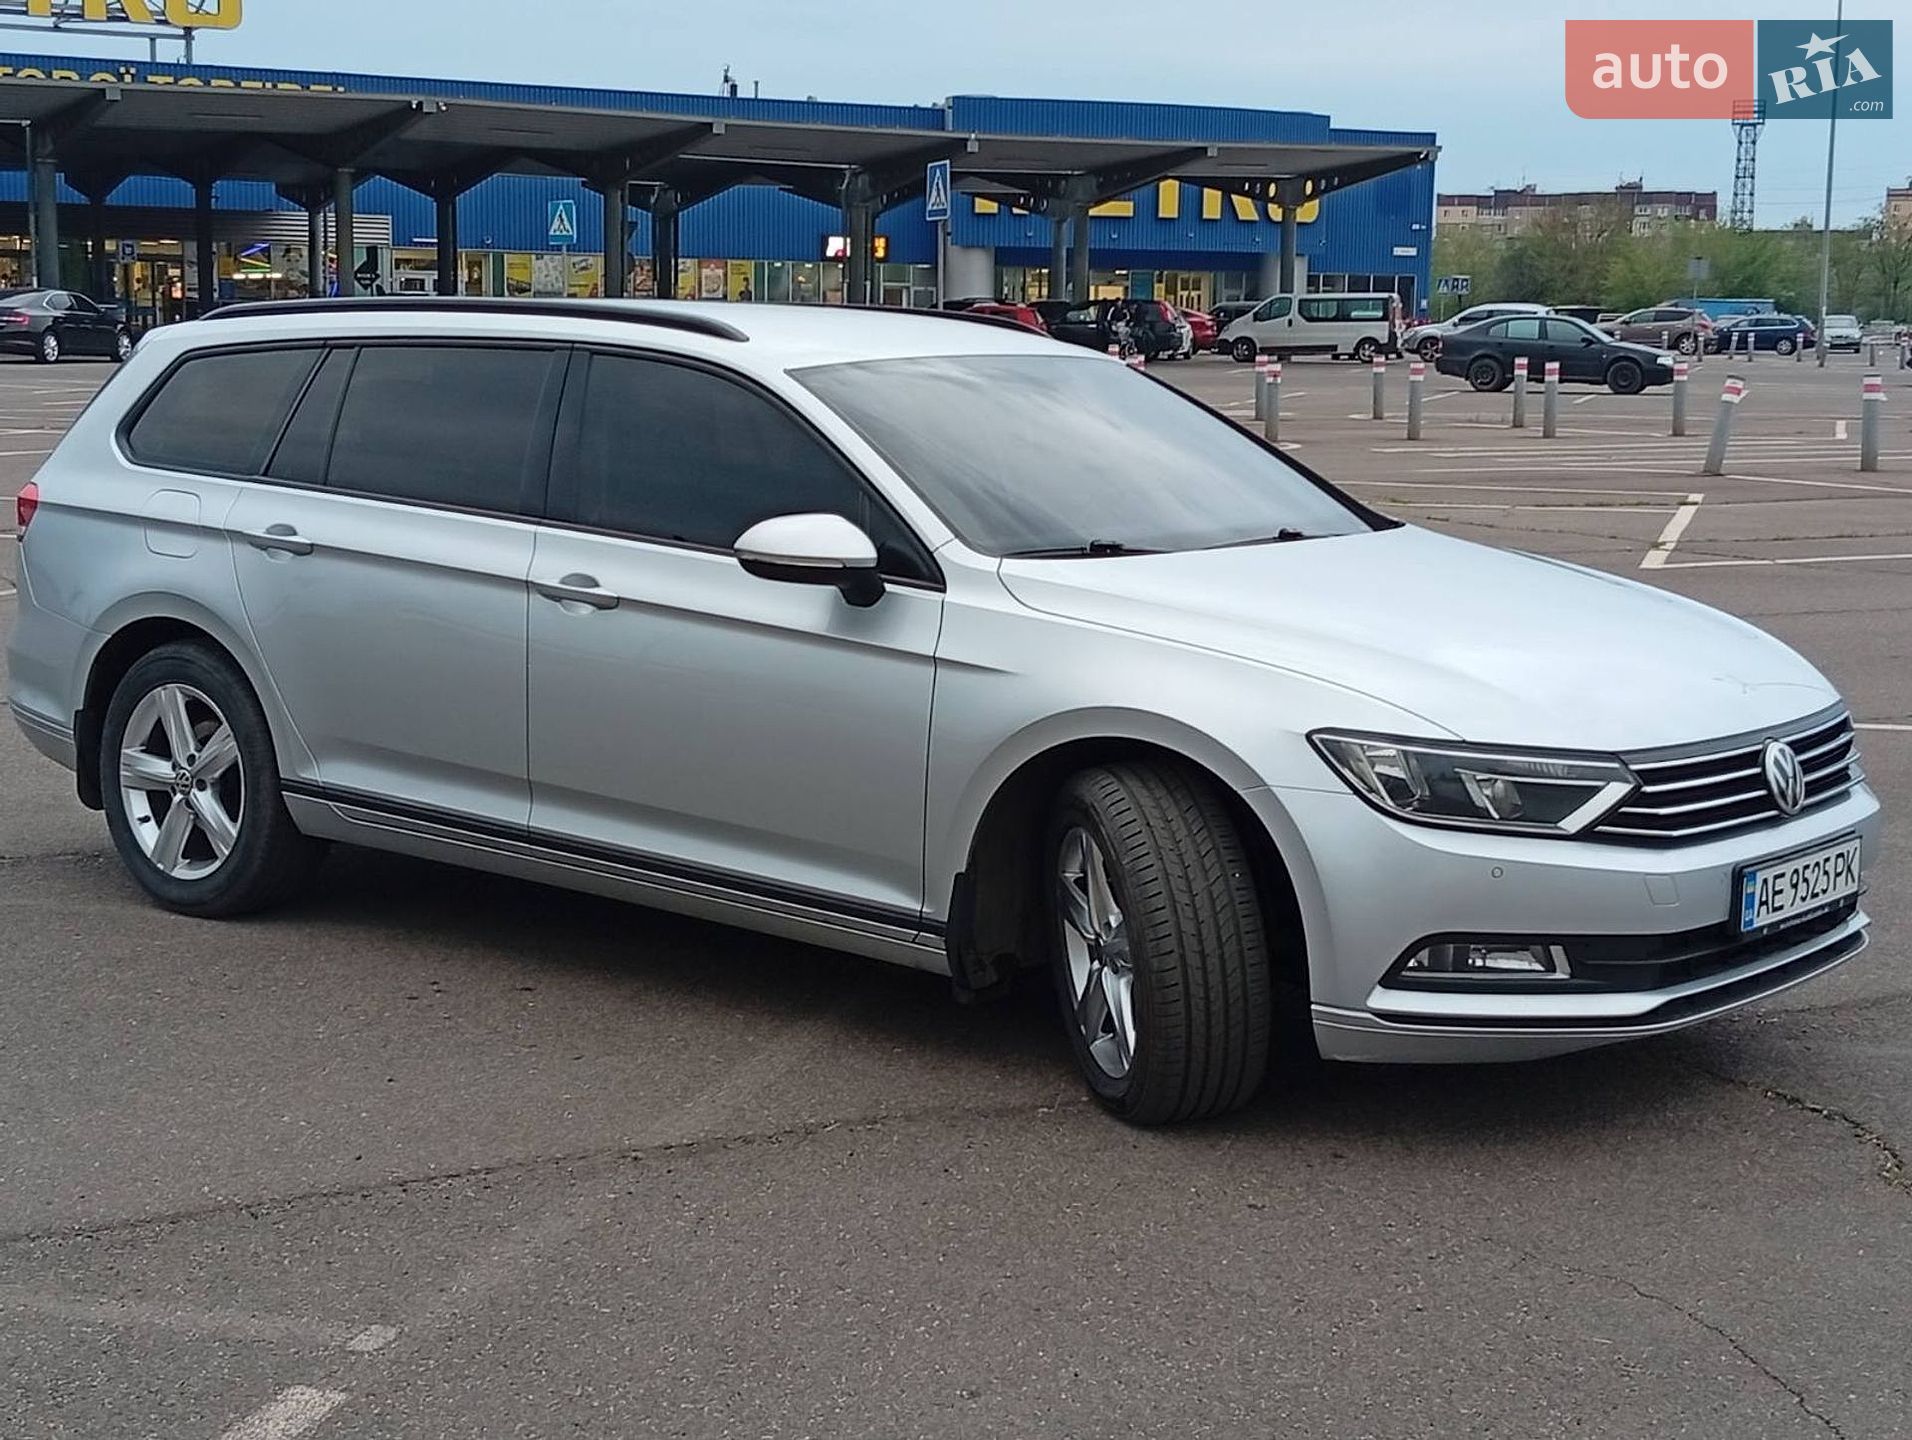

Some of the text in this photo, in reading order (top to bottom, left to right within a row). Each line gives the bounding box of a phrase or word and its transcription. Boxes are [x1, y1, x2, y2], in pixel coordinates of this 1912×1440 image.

[1756, 871, 1786, 919] AE
[1789, 855, 1832, 908] 9525
[1832, 846, 1858, 892] PK
